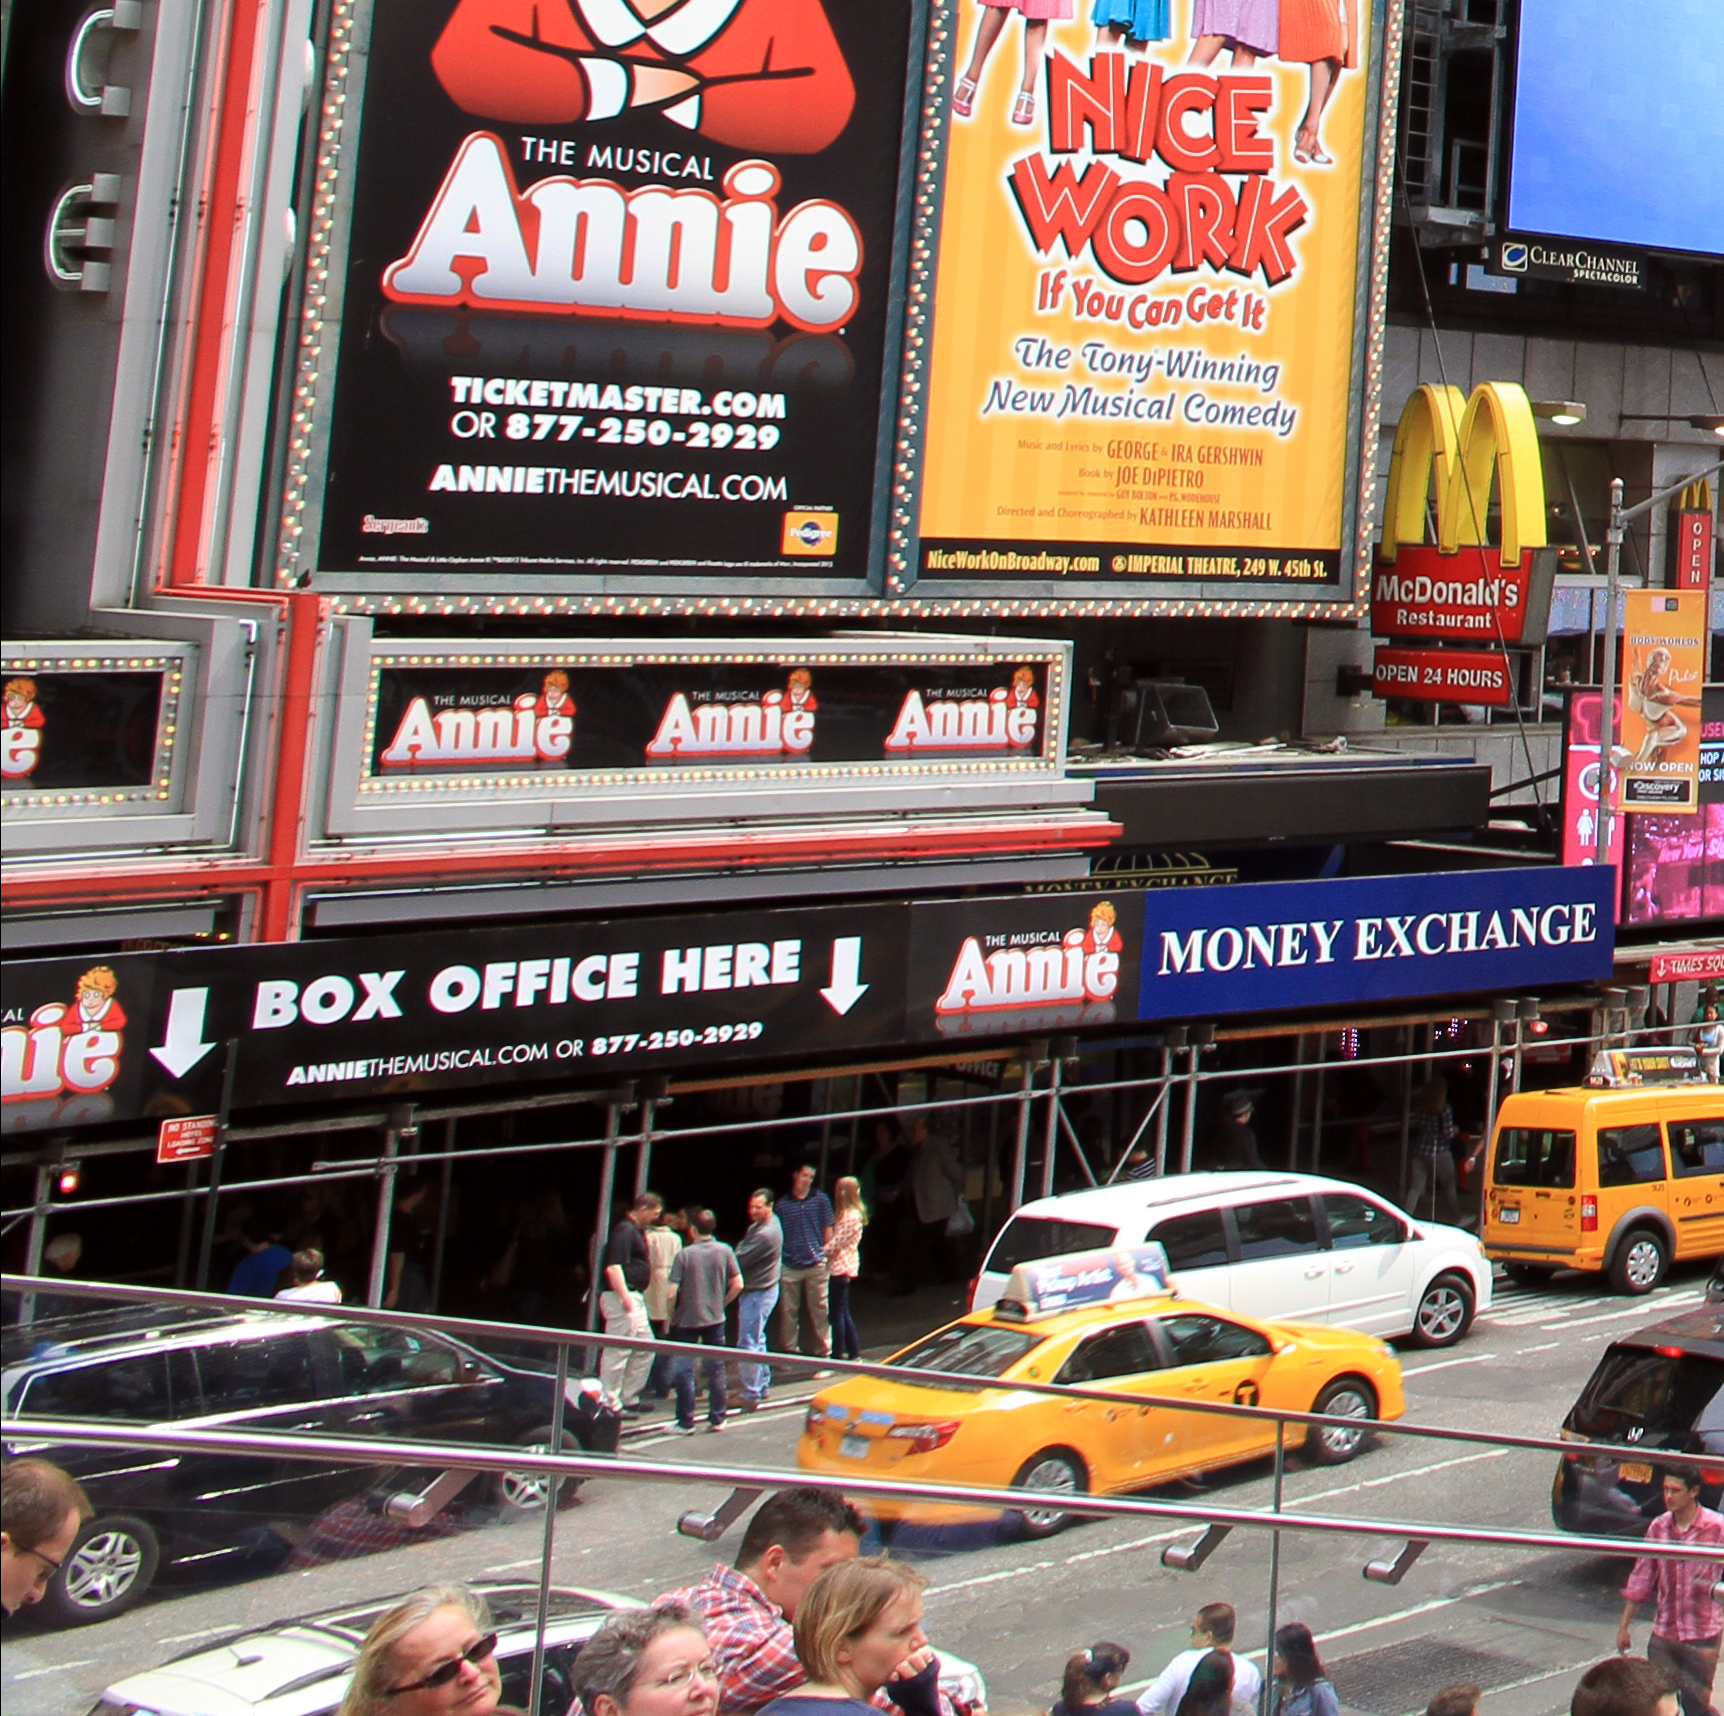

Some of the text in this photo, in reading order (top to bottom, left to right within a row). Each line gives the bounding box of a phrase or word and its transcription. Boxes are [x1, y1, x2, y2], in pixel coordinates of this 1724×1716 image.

[1044, 47, 1276, 174] NICE
[522, 137, 714, 181] THE MUSICAL
[382, 130, 864, 334] Annie
[1007, 152, 1308, 287] WORK
[1078, 466, 1204, 488] Book by JOE DiPIETRO
[790, 527, 833, 542] Pedigree
[1692, 520, 1702, 585] OPEN
[1375, 575, 1519, 608] McDonald's
[1397, 609, 1492, 629] Restaurant
[1629, 636, 1700, 646] BODY WORLDS
[1376, 665, 1503, 688] OPEN 24 HOURS
[1668, 666, 1699, 686] Pulse
[381, 693, 575, 766] Annie
[645, 687, 816, 758] Annie
[1659, 761, 1694, 773] OPEN
[985, 931, 1061, 947] THE MUSICAL
[1158, 902, 1598, 976] MONEY EXCHANGE
[253, 939, 802, 1031] BOX OFFICE HERE
